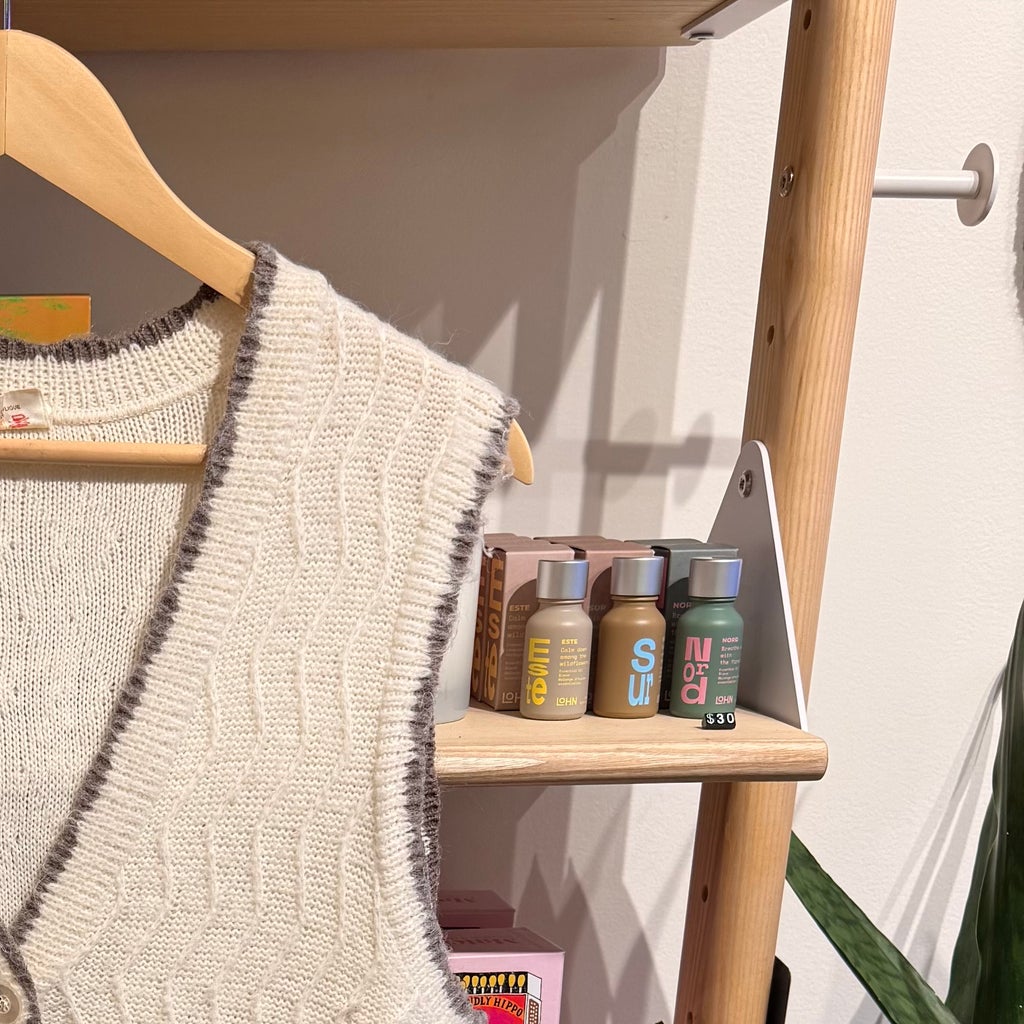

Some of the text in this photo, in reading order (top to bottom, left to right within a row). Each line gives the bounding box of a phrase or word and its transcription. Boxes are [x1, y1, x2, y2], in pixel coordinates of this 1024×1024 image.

[556, 696, 578, 707] LOHN
[706, 712, 735, 724] $30
[493, 997, 524, 1017] HIPPO
